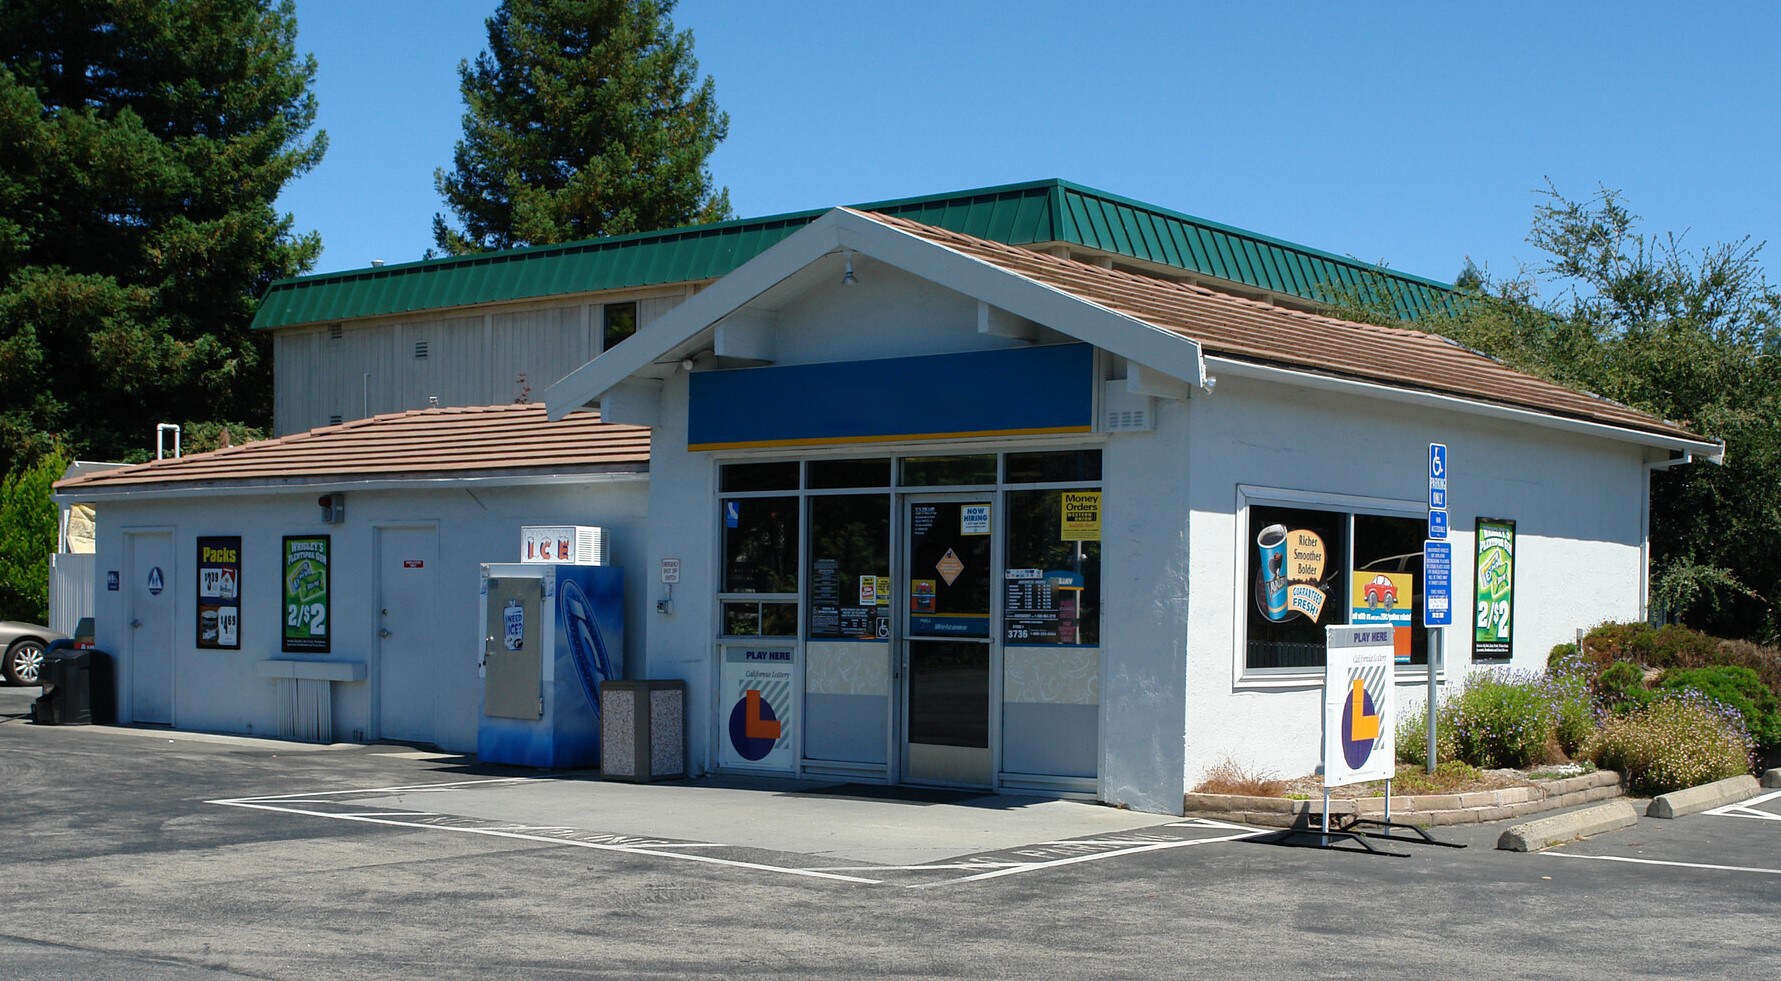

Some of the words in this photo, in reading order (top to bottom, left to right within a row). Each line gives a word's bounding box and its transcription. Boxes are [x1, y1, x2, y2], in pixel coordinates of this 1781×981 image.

[1066, 494, 1098, 503] Money
[1433, 491, 1443, 504] ONLY
[1066, 503, 1097, 511] Orders
[291, 541, 324, 552] WRIGLEY'S
[1299, 535, 1318, 547] Richer
[527, 536, 570, 560] ICE
[203, 547, 237, 562] Packs
[1294, 549, 1322, 561] Smoother
[1298, 563, 1317, 575] Bolder
[1293, 587, 1323, 605] GUARANTEED
[1293, 598, 1319, 618] FRESH!
[288, 603, 326, 635] 2/$2
[507, 614, 522, 623] NEED
[1478, 600, 1509, 638] 2/$2
[1008, 630, 1028, 639] 3736
[1353, 633, 1371, 643] PLAY
[1371, 632, 1388, 642] HERE
[746, 651, 768, 660] PLAY
[769, 651, 790, 661] HERE
[745, 670, 771, 679] California
[772, 671, 791, 681] Lottery
